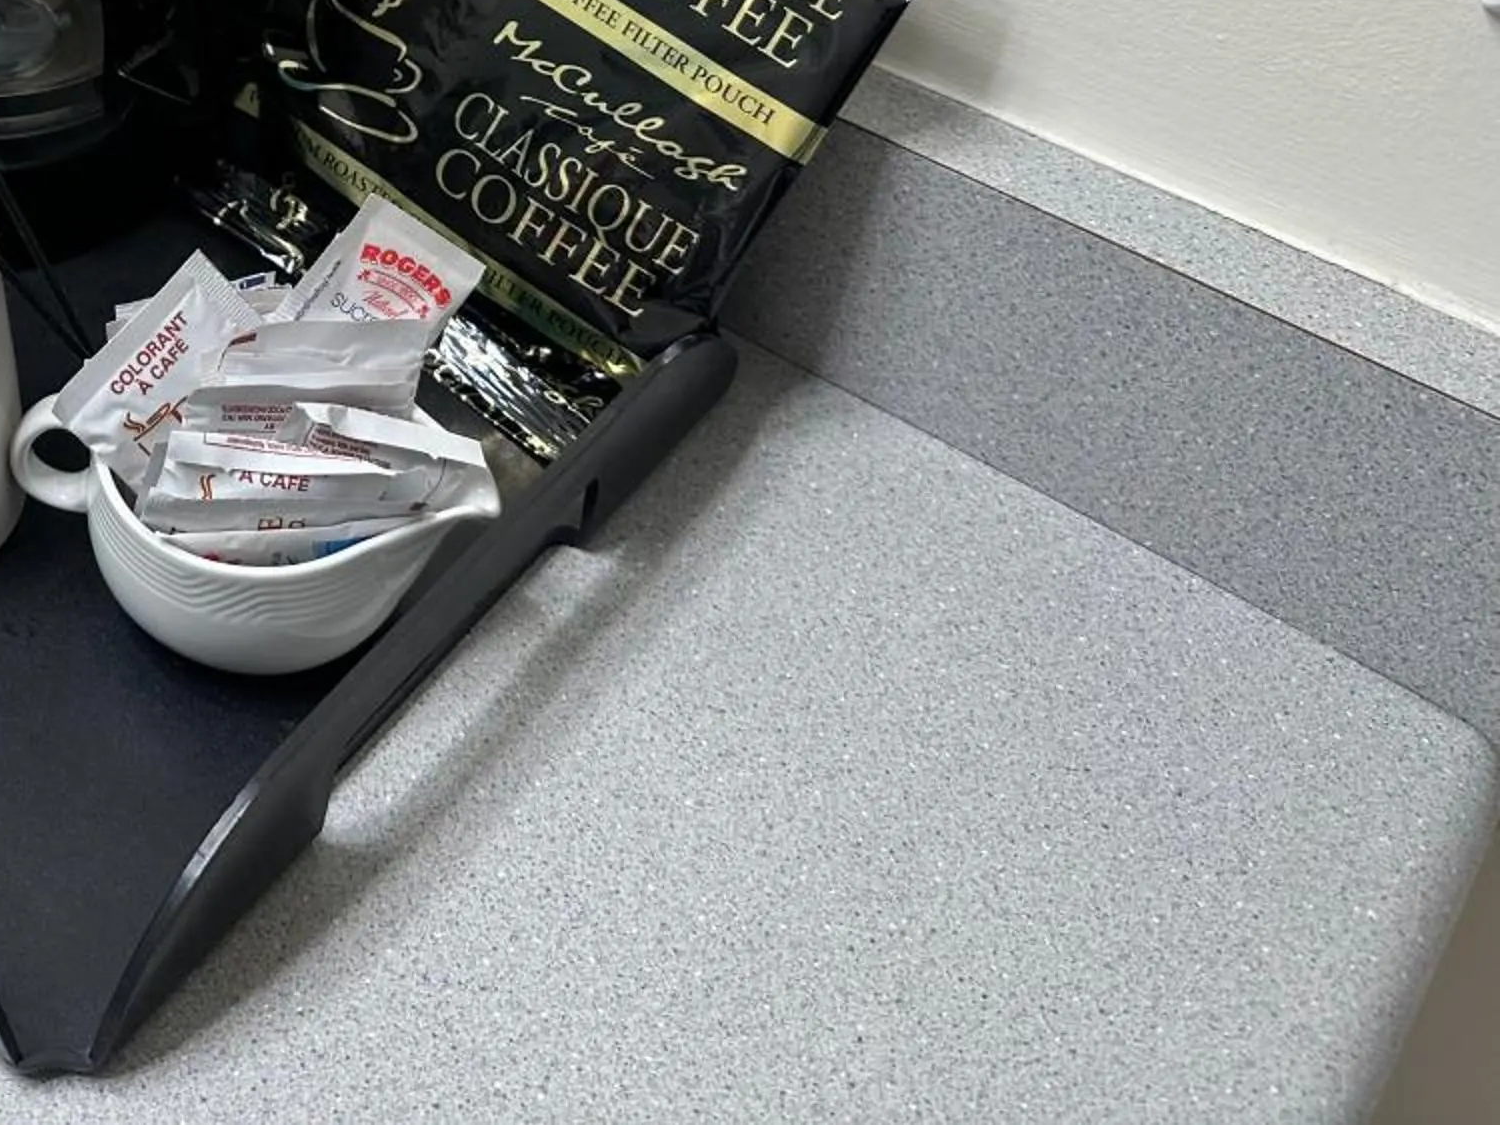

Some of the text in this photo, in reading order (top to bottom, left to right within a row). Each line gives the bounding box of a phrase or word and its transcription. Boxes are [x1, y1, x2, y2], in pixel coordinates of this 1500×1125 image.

[621, 20, 692, 75] FILTER
[690, 63, 777, 125] POUCH
[454, 92, 700, 275] CLASSIQUE
[359, 243, 452, 309] ROGERS
[435, 148, 656, 318] COFFEE
[109, 310, 189, 395] COLORANT
[135, 337, 190, 395] À CAFÉ
